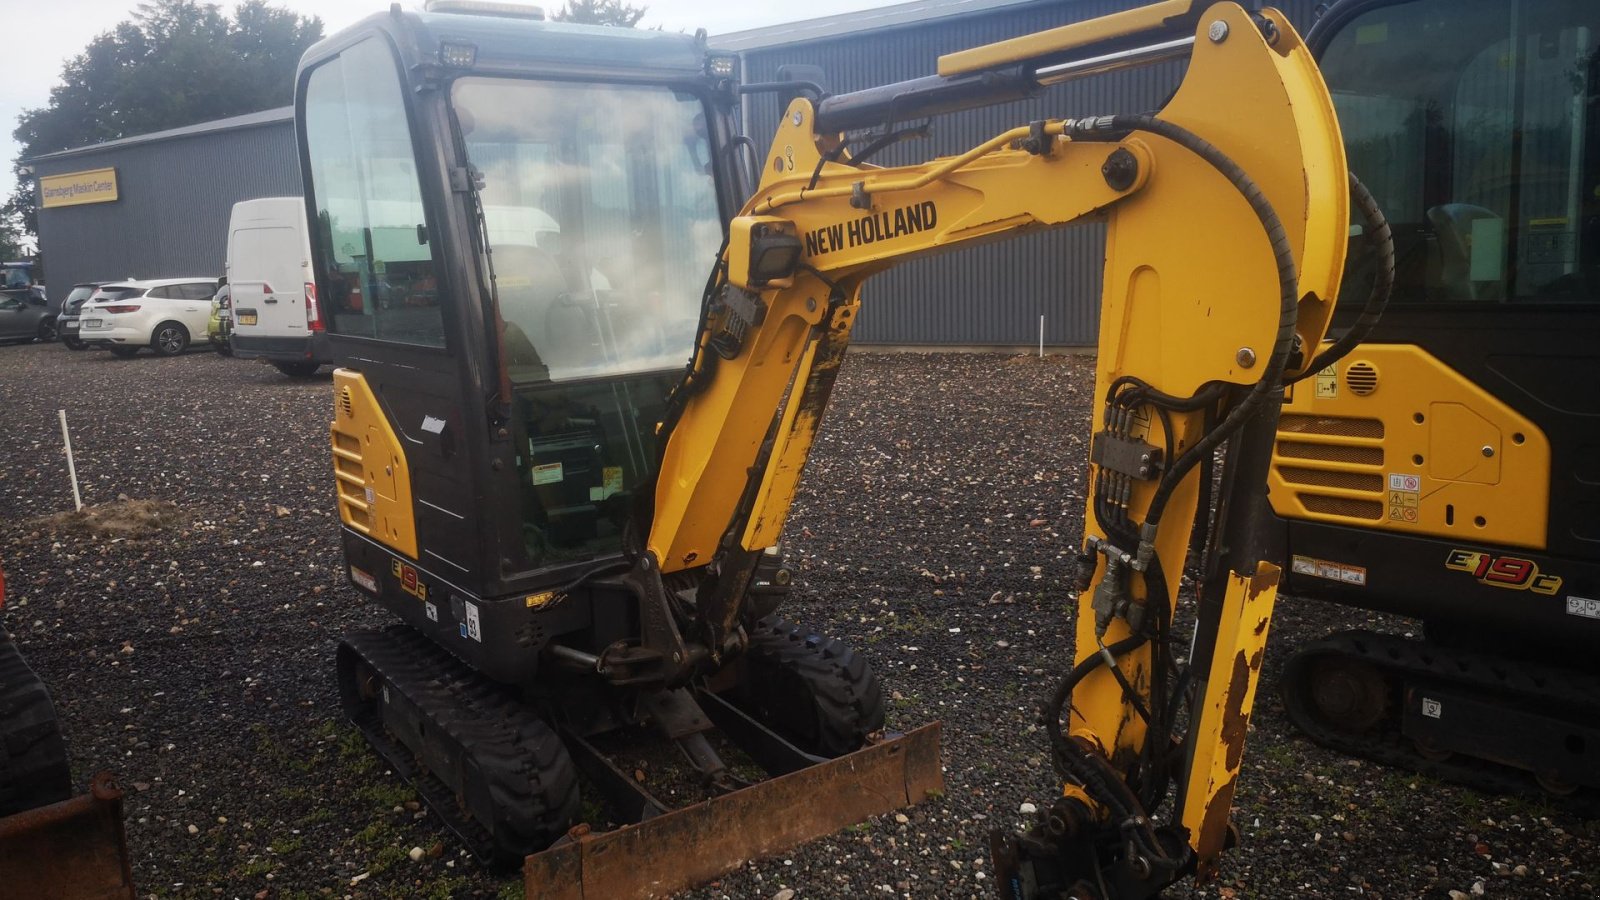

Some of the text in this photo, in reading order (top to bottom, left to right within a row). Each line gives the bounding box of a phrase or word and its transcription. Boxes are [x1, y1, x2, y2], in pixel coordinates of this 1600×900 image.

[73, 183, 93, 194] Maskin
[94, 181, 112, 192] Center
[805, 200, 937, 258] NEW HOLLAND
